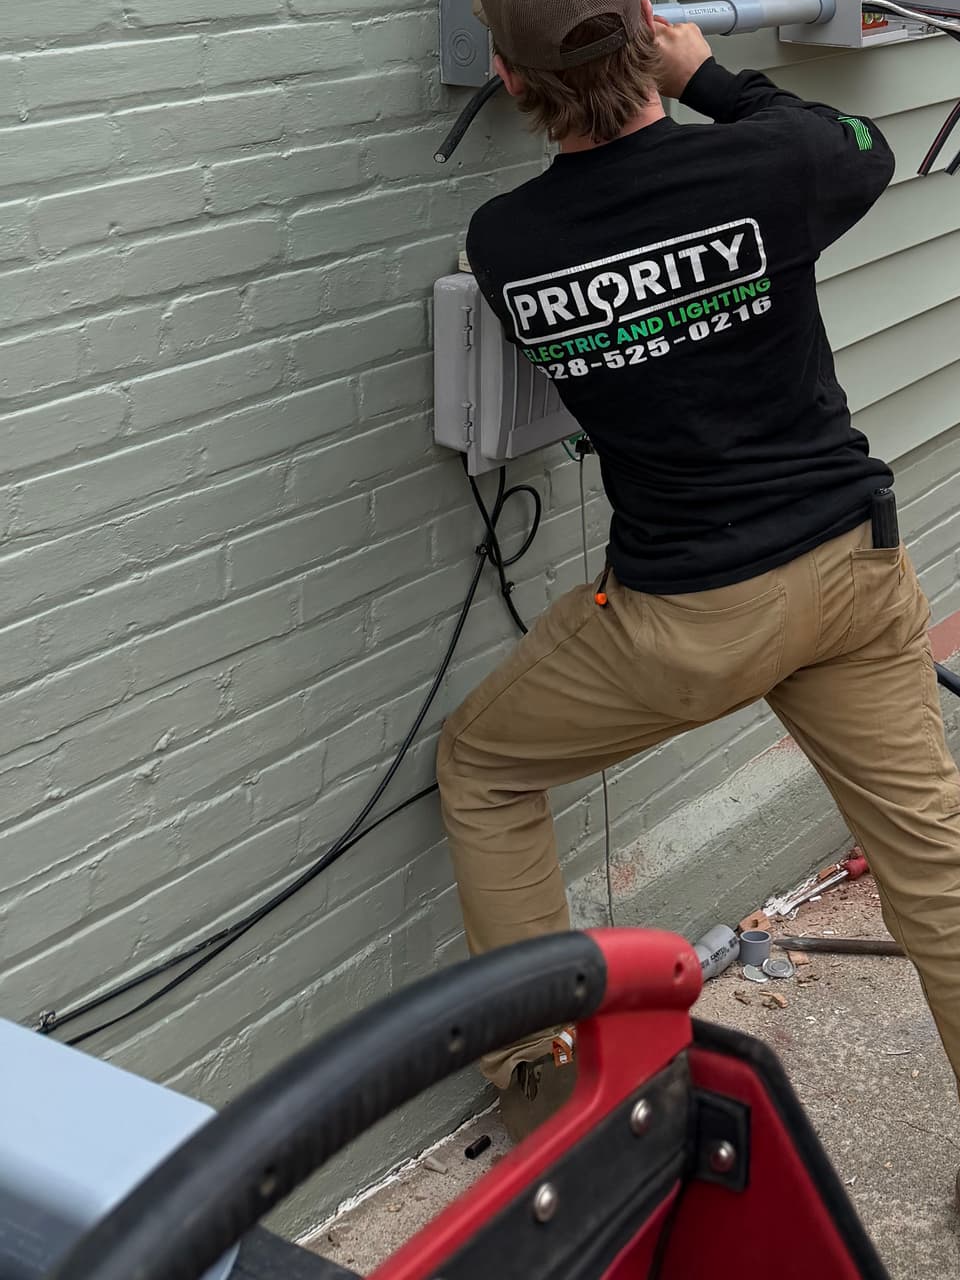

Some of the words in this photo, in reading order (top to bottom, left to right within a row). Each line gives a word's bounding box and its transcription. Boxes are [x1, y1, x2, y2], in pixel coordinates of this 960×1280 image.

[513, 232, 745, 331] PRIORITY
[522, 332, 611, 363] ELECTRIC
[617, 316, 664, 345] AND
[671, 277, 772, 328] LIGHTING
